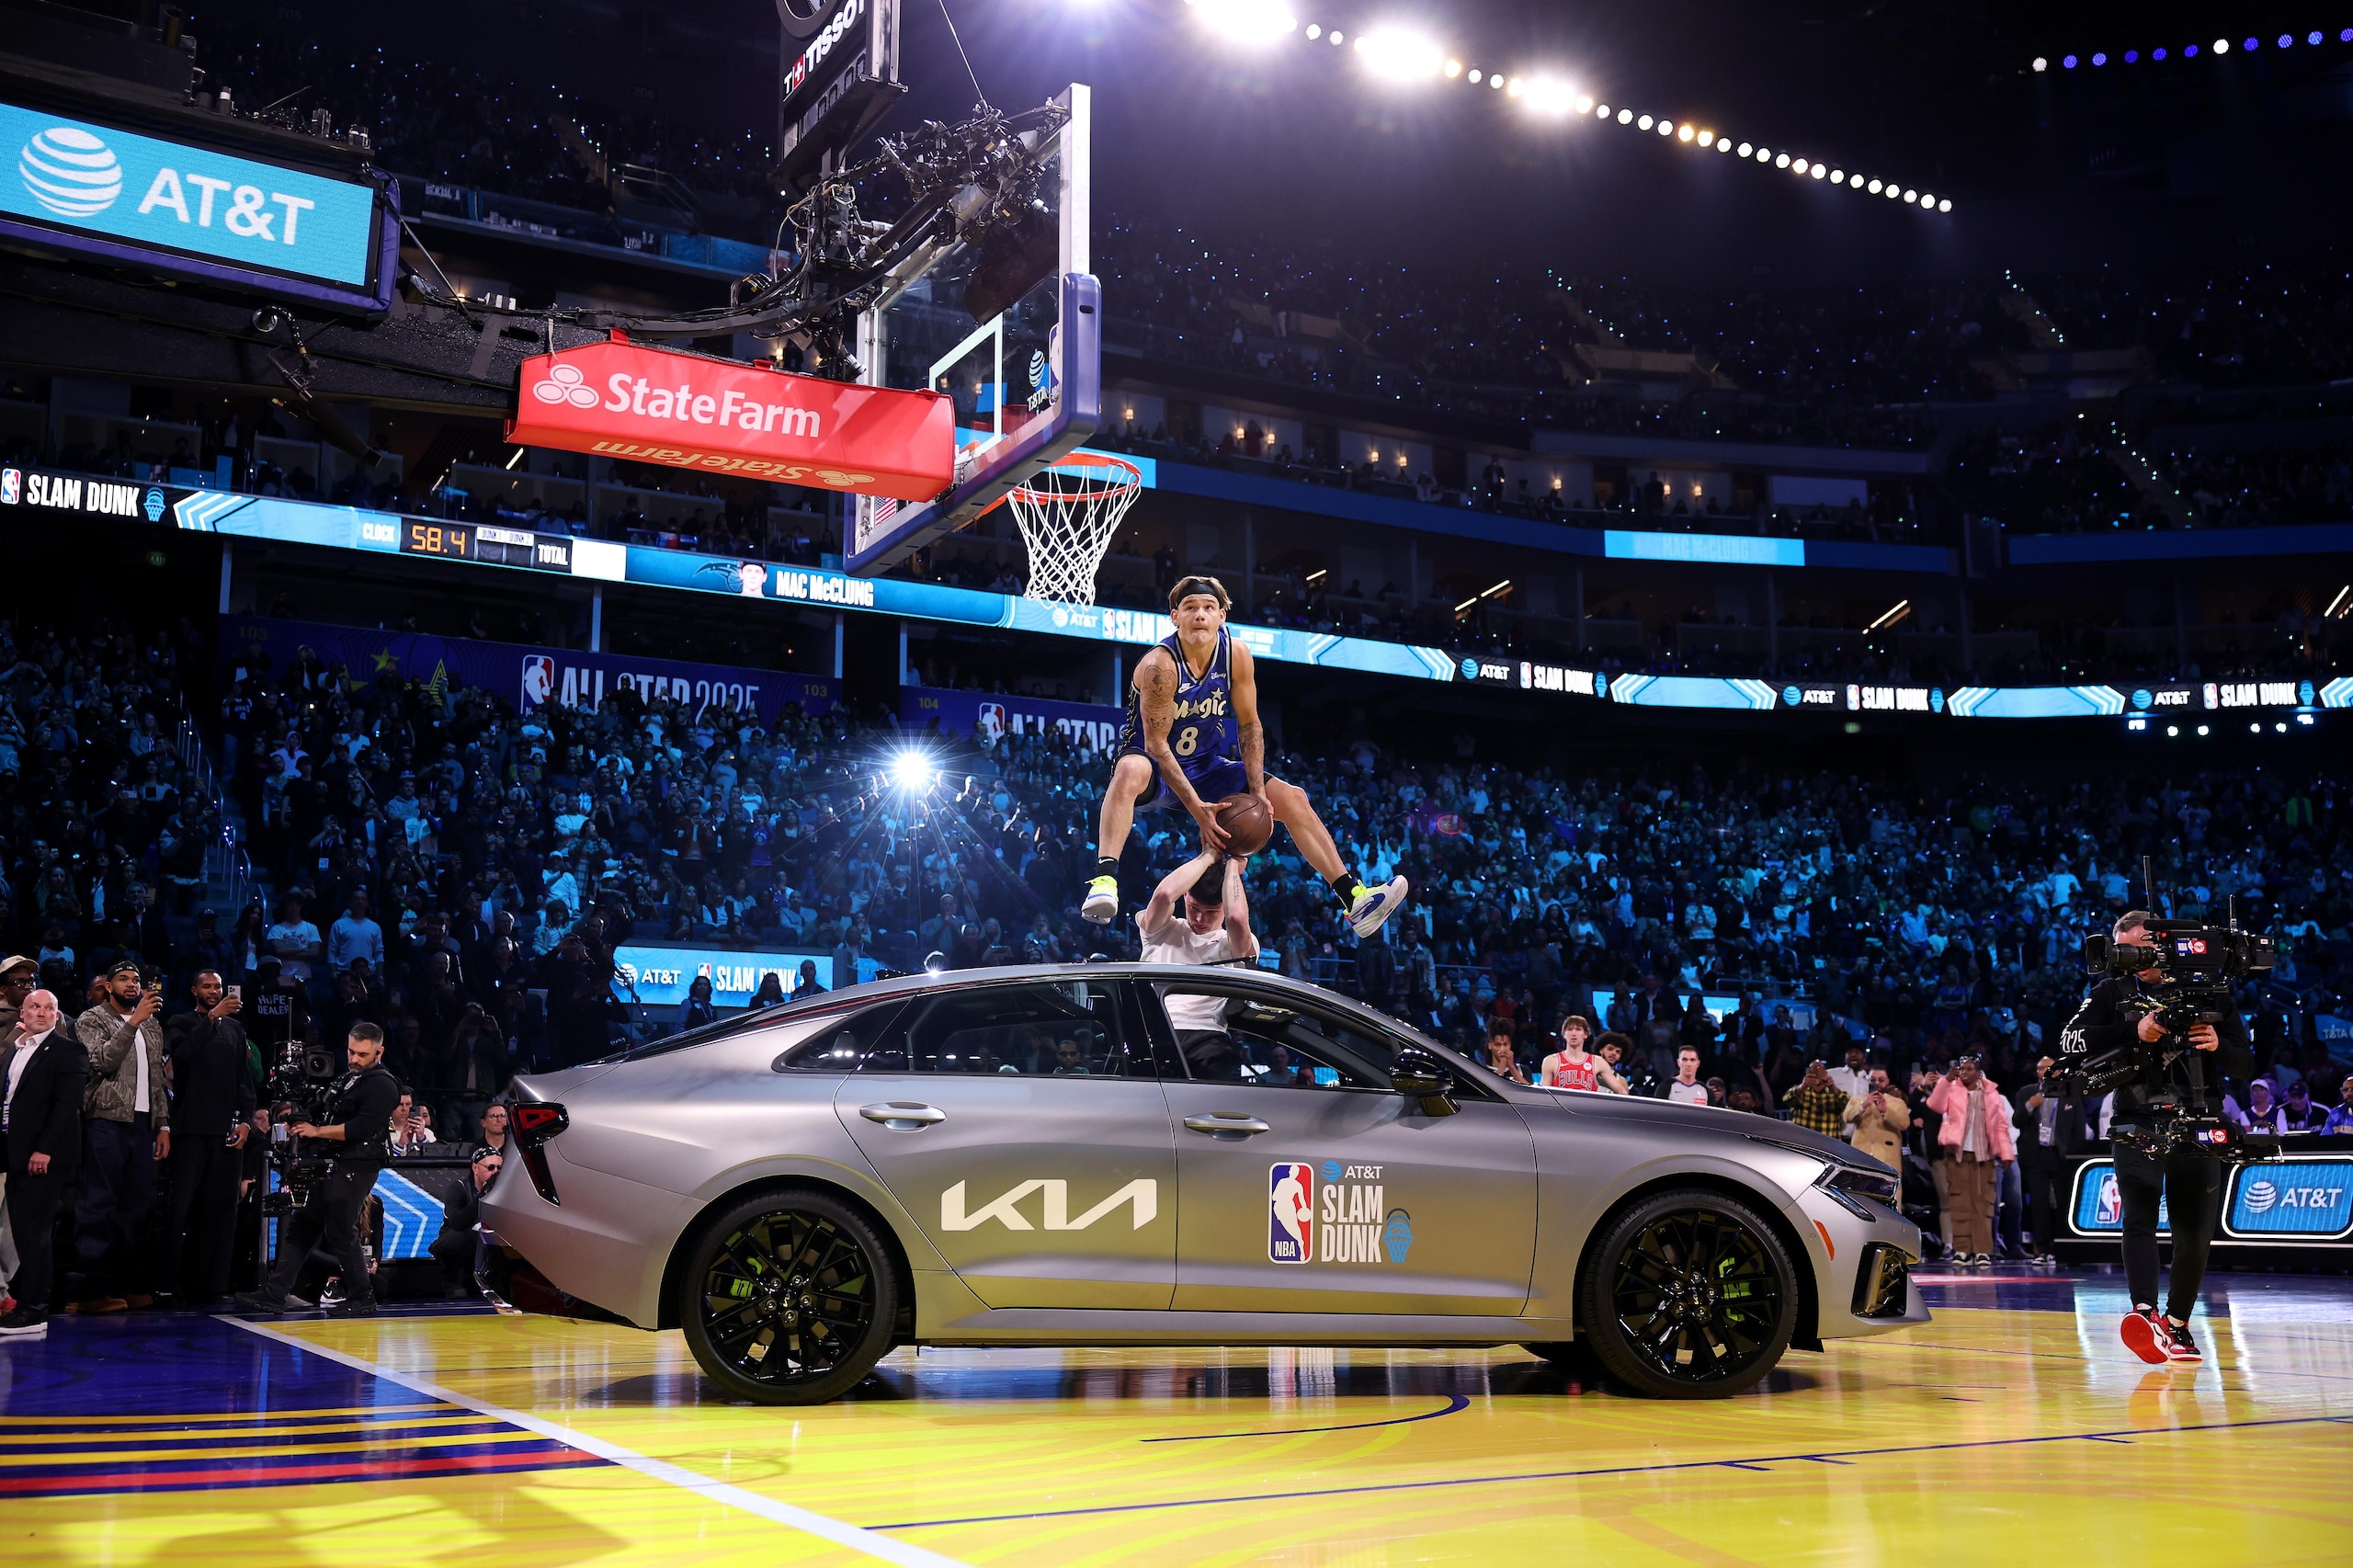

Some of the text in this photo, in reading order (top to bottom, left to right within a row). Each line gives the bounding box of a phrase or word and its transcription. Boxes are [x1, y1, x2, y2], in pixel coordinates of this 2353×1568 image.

[138, 167, 315, 245] AT&T
[604, 372, 822, 438] State Farm
[27, 473, 140, 517] SLAM DUNK
[362, 523, 395, 541] CLOCK
[411, 525, 466, 555] 58.4
[537, 543, 568, 566] TOTAL
[777, 570, 874, 608] MAC McCLUNG
[1069, 613, 1098, 628] AT&T
[1115, 610, 1155, 643] SLAM
[1479, 664, 1510, 680] AT&T
[1533, 665, 1595, 695] SLAM DUNK
[802, 683, 828, 699] 103
[1802, 689, 1836, 704] AT&T
[1861, 687, 1929, 711] SLAM DUNK
[2154, 691, 2191, 706] AT&T
[2220, 682, 2298, 707] SLAM DUNK
[918, 697, 939, 710] 104
[1176, 726, 1199, 756] 8
[642, 969, 681, 984] AT&T
[716, 965, 755, 993] SLAM
[1345, 1165, 1383, 1179] AT&T
[941, 1178, 1157, 1231] KIA
[1322, 1184, 1383, 1223] SLAM
[2279, 1187, 2342, 1209] AT&T
[1275, 1241, 1296, 1257] NBA
[1321, 1224, 1382, 1263] DUNK
